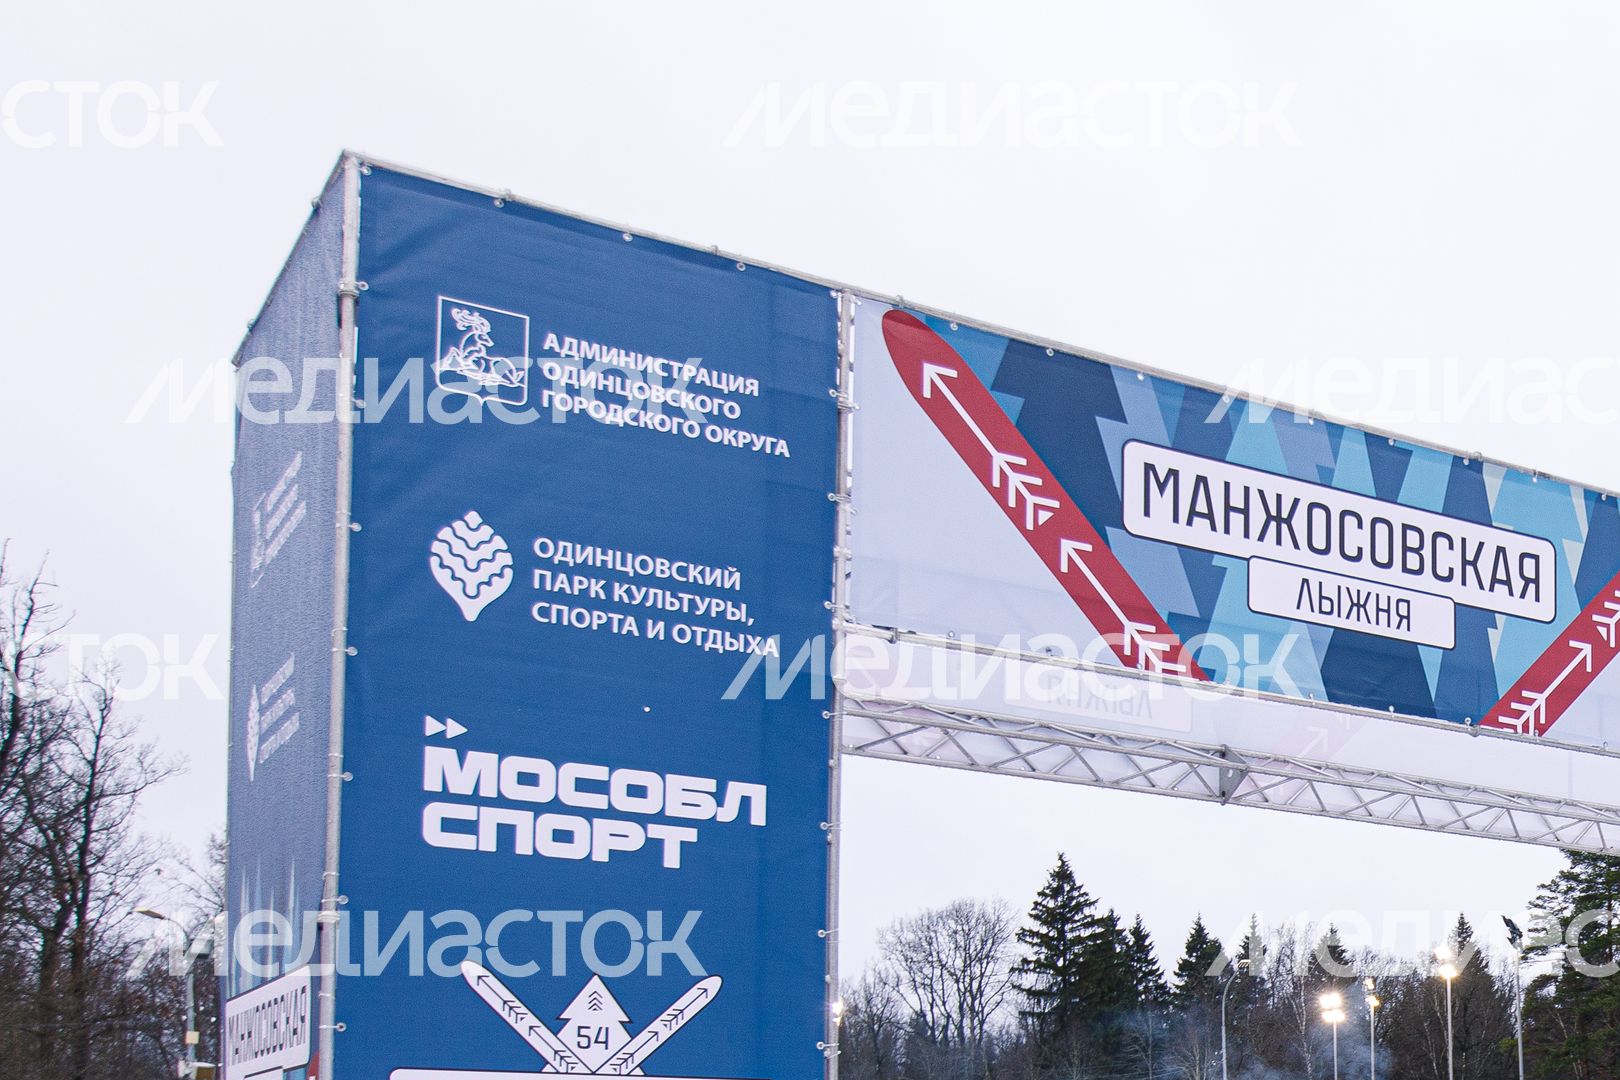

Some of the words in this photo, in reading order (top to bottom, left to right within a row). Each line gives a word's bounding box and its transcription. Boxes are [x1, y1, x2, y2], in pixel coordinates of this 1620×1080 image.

[542, 362, 741, 420] ОДИНЦОВСКОГО
[543, 333, 759, 397] АДМИНИСТРАЦИЯ
[542, 390, 701, 438] ГОРОДСКОГО
[705, 425, 791, 458] ОКРУГА
[1141, 462, 1543, 605] МАНЖОСОВСКАЯ
[533, 537, 742, 591] ОДИНЦОВСКИЙ
[533, 569, 606, 600] ПАРК
[613, 582, 755, 626] КУЛЬТУРЫ,
[1294, 577, 1413, 632] ЛЫЖНЯ
[531, 602, 640, 637] СПОРТА
[647, 619, 665, 641] И
[672, 623, 780, 658] ОТДЫХА
[423, 745, 767, 827] МОСОБЛ
[421, 801, 698, 869] СПОРТ
[577, 1025, 609, 1051] 54
